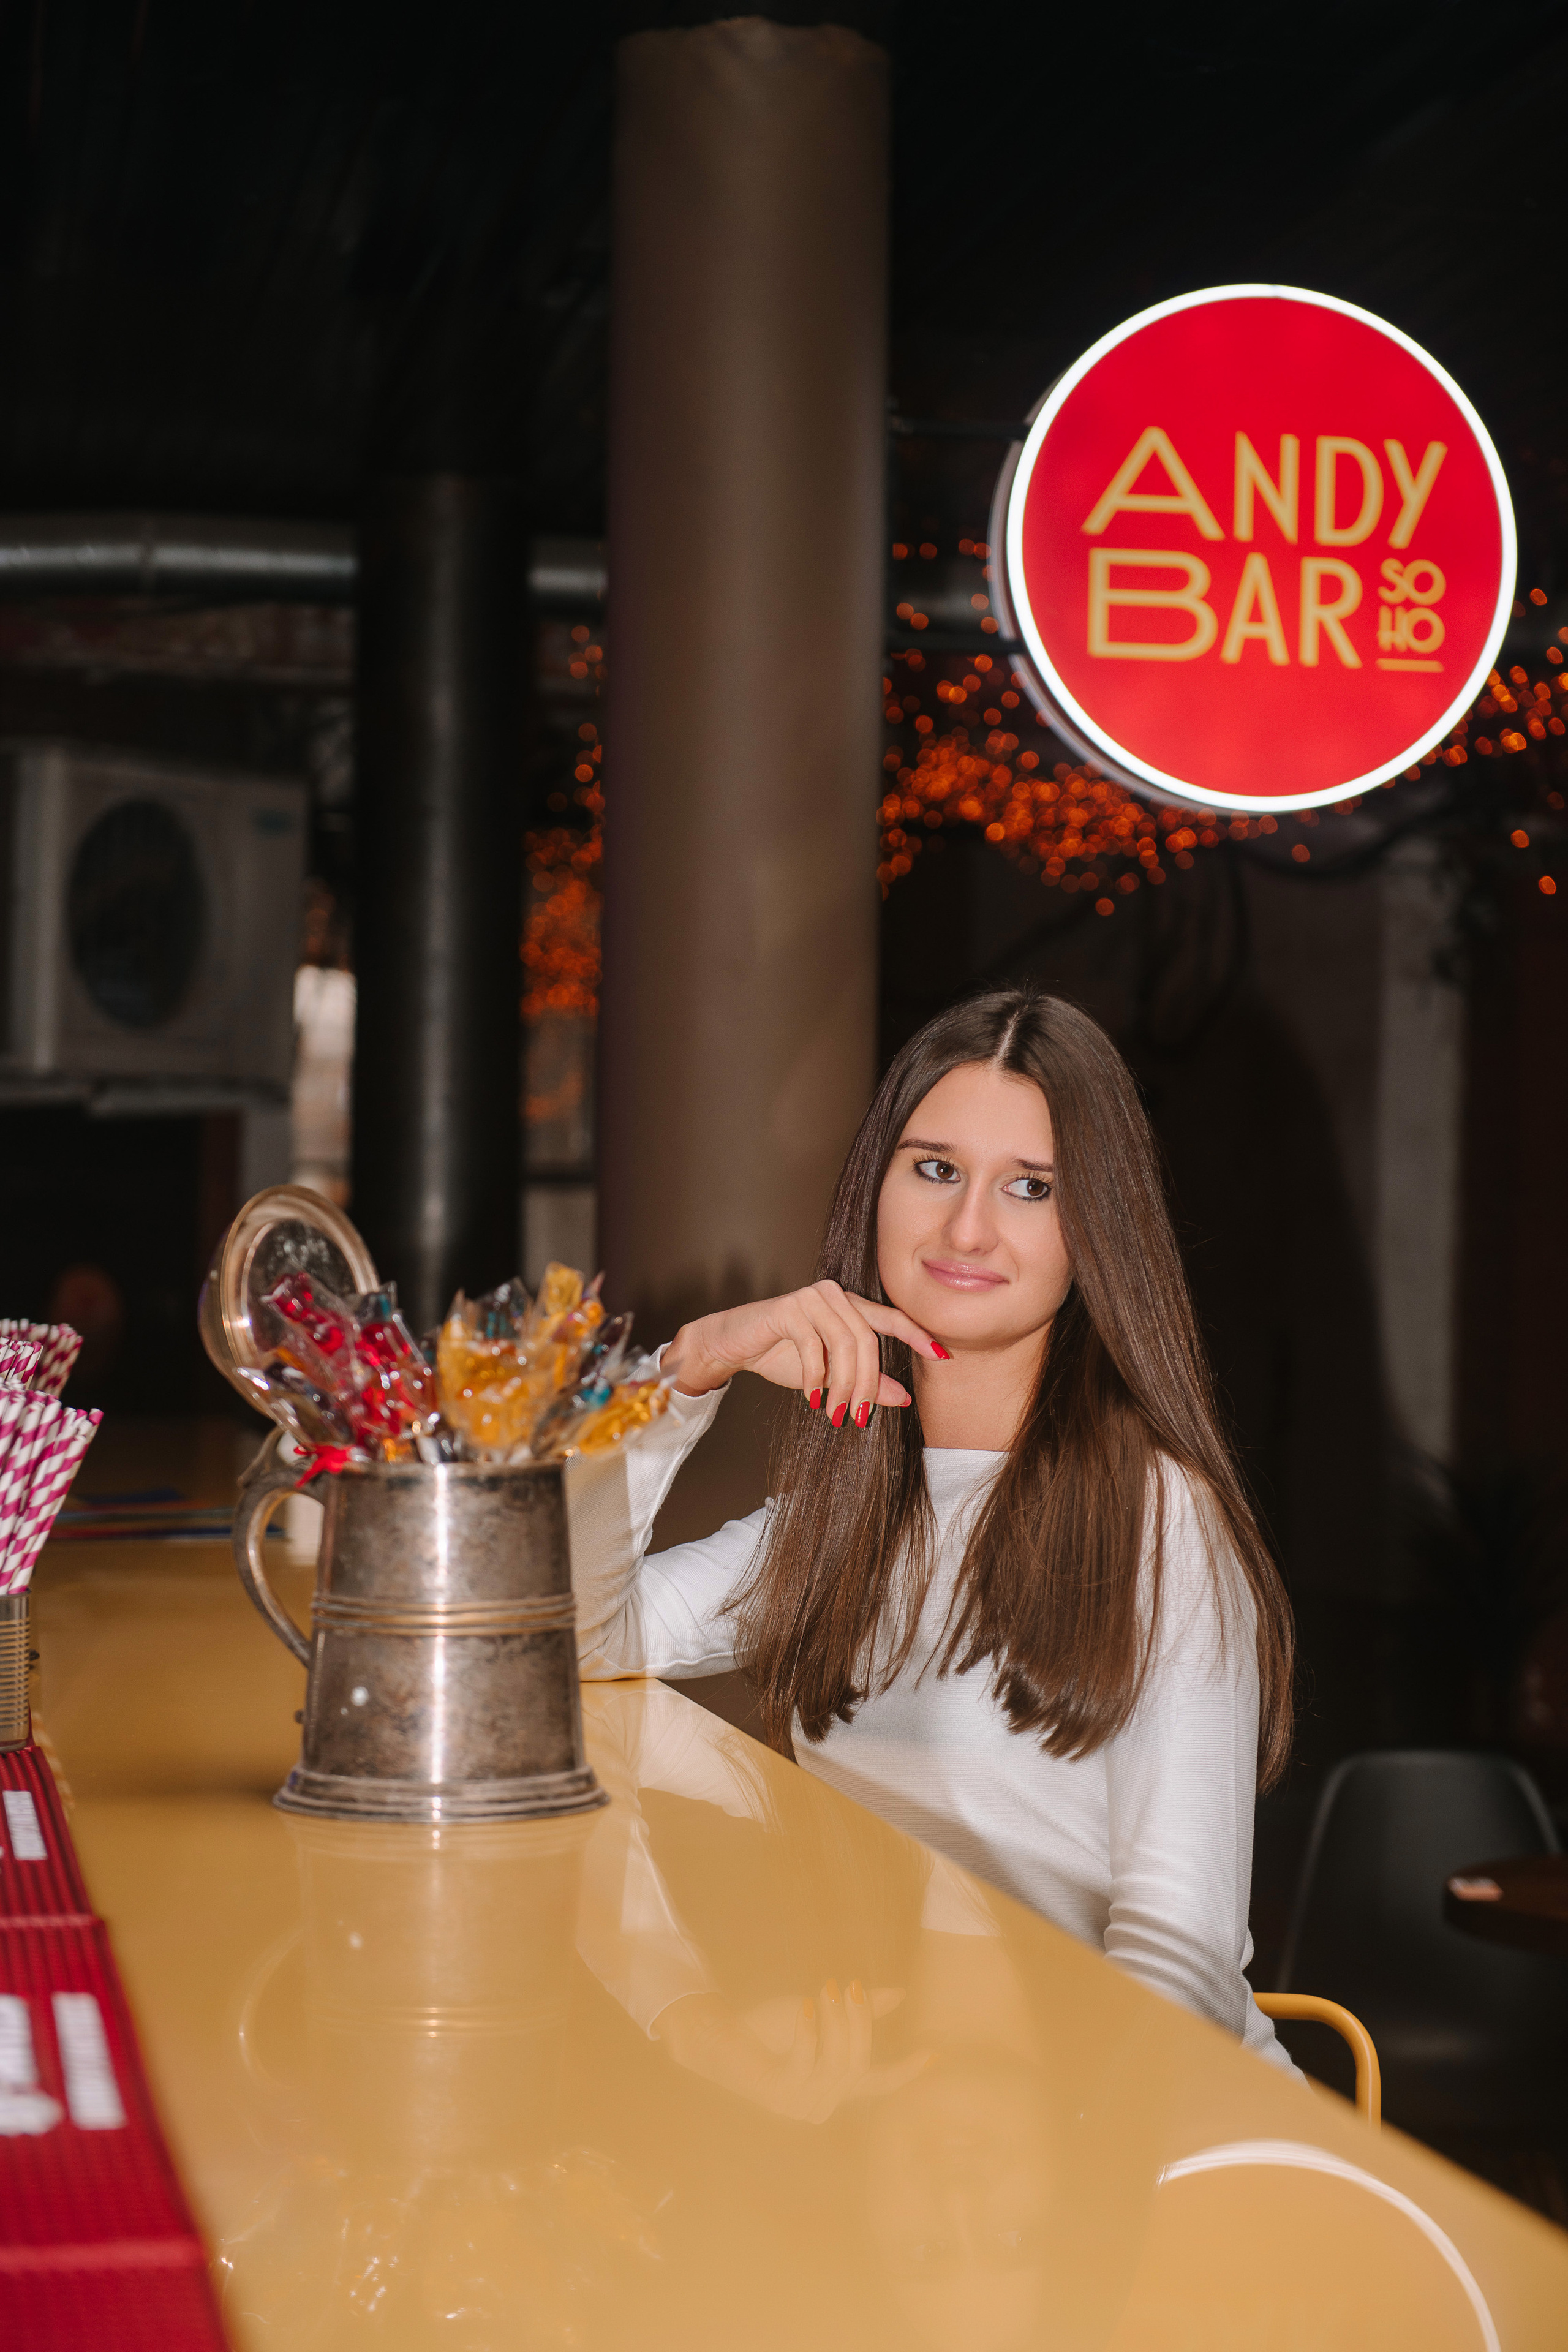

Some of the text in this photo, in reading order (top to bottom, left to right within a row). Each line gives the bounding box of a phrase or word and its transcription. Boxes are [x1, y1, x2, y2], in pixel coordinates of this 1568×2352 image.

[1082, 427, 1447, 549] ANDY
[1087, 547, 1363, 669] BAR
[1378, 557, 1446, 606] SO
